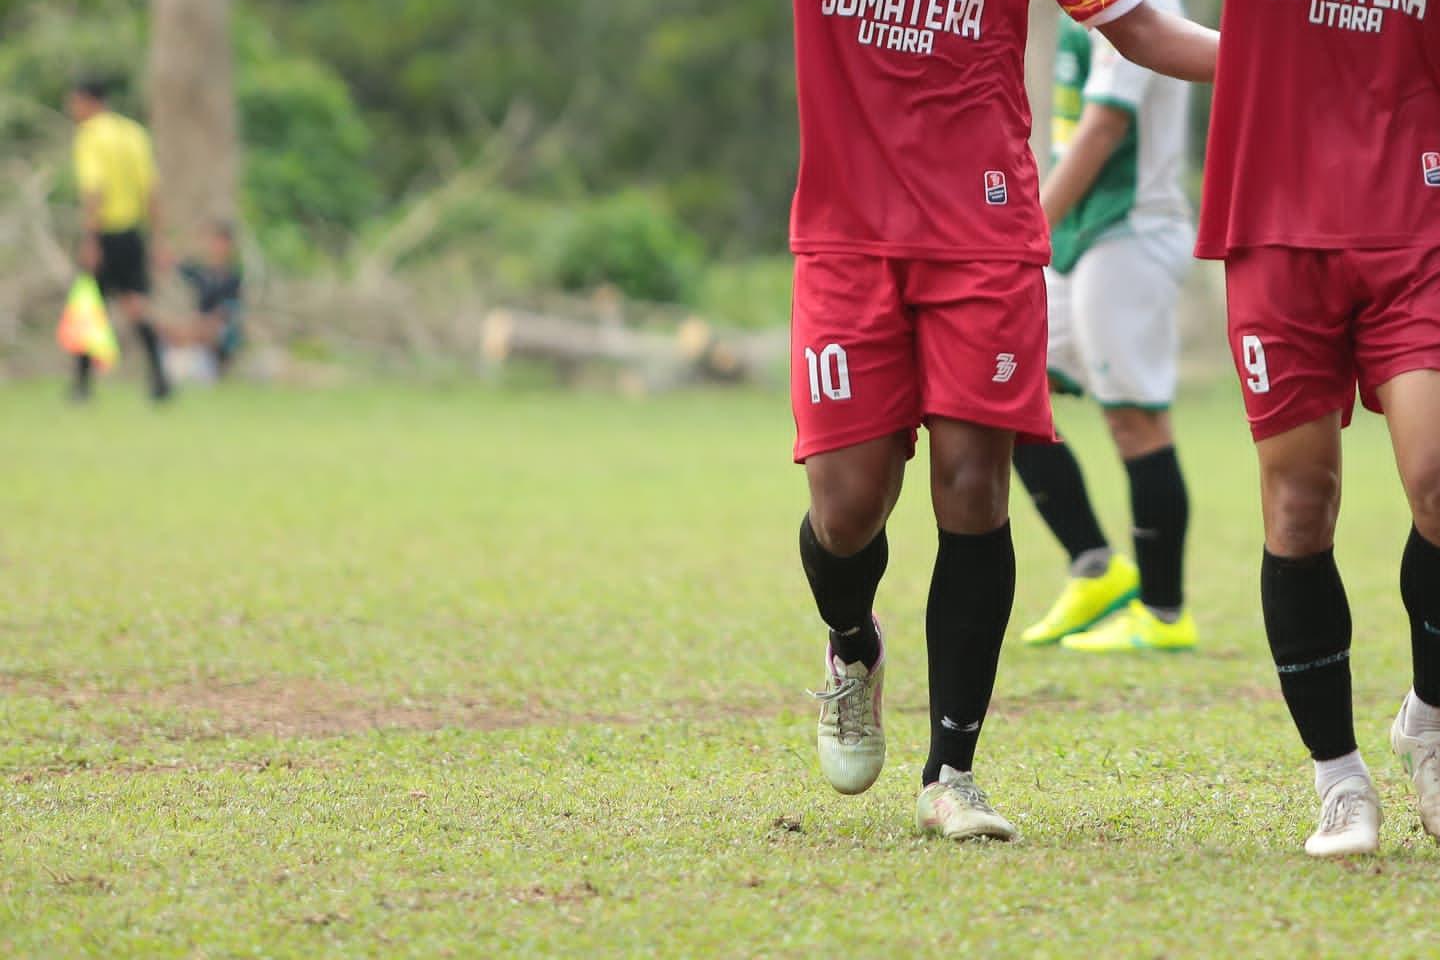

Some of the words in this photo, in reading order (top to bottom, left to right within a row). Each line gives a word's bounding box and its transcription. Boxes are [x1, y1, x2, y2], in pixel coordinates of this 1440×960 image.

[858, 19, 934, 55] UTARA
[805, 343, 851, 405] 10
[1242, 335, 1270, 393] 9
